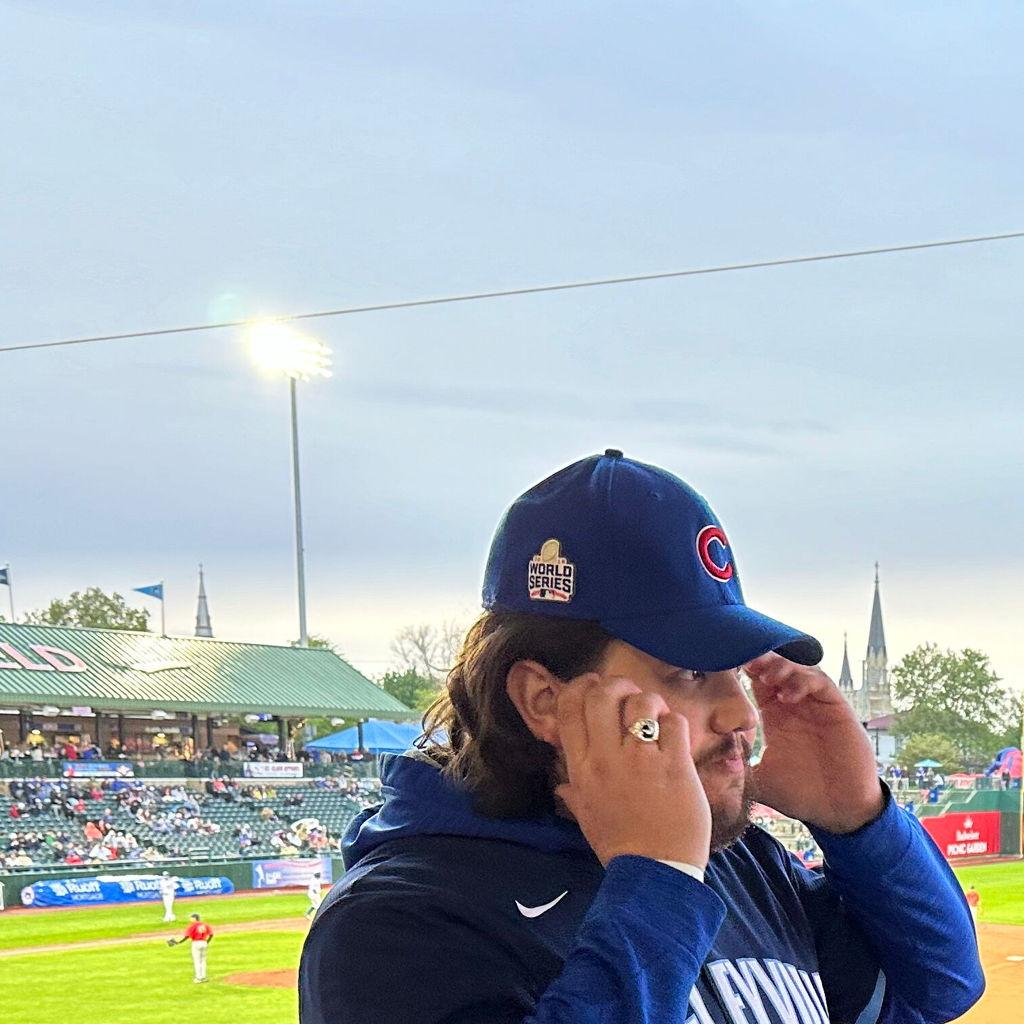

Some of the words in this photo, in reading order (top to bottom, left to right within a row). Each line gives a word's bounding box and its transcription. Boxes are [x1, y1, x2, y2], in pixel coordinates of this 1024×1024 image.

[696, 524, 733, 582] C
[530, 563, 572, 577] WORLD
[529, 575, 572, 593] SERIES
[0, 642, 87, 673] LD
